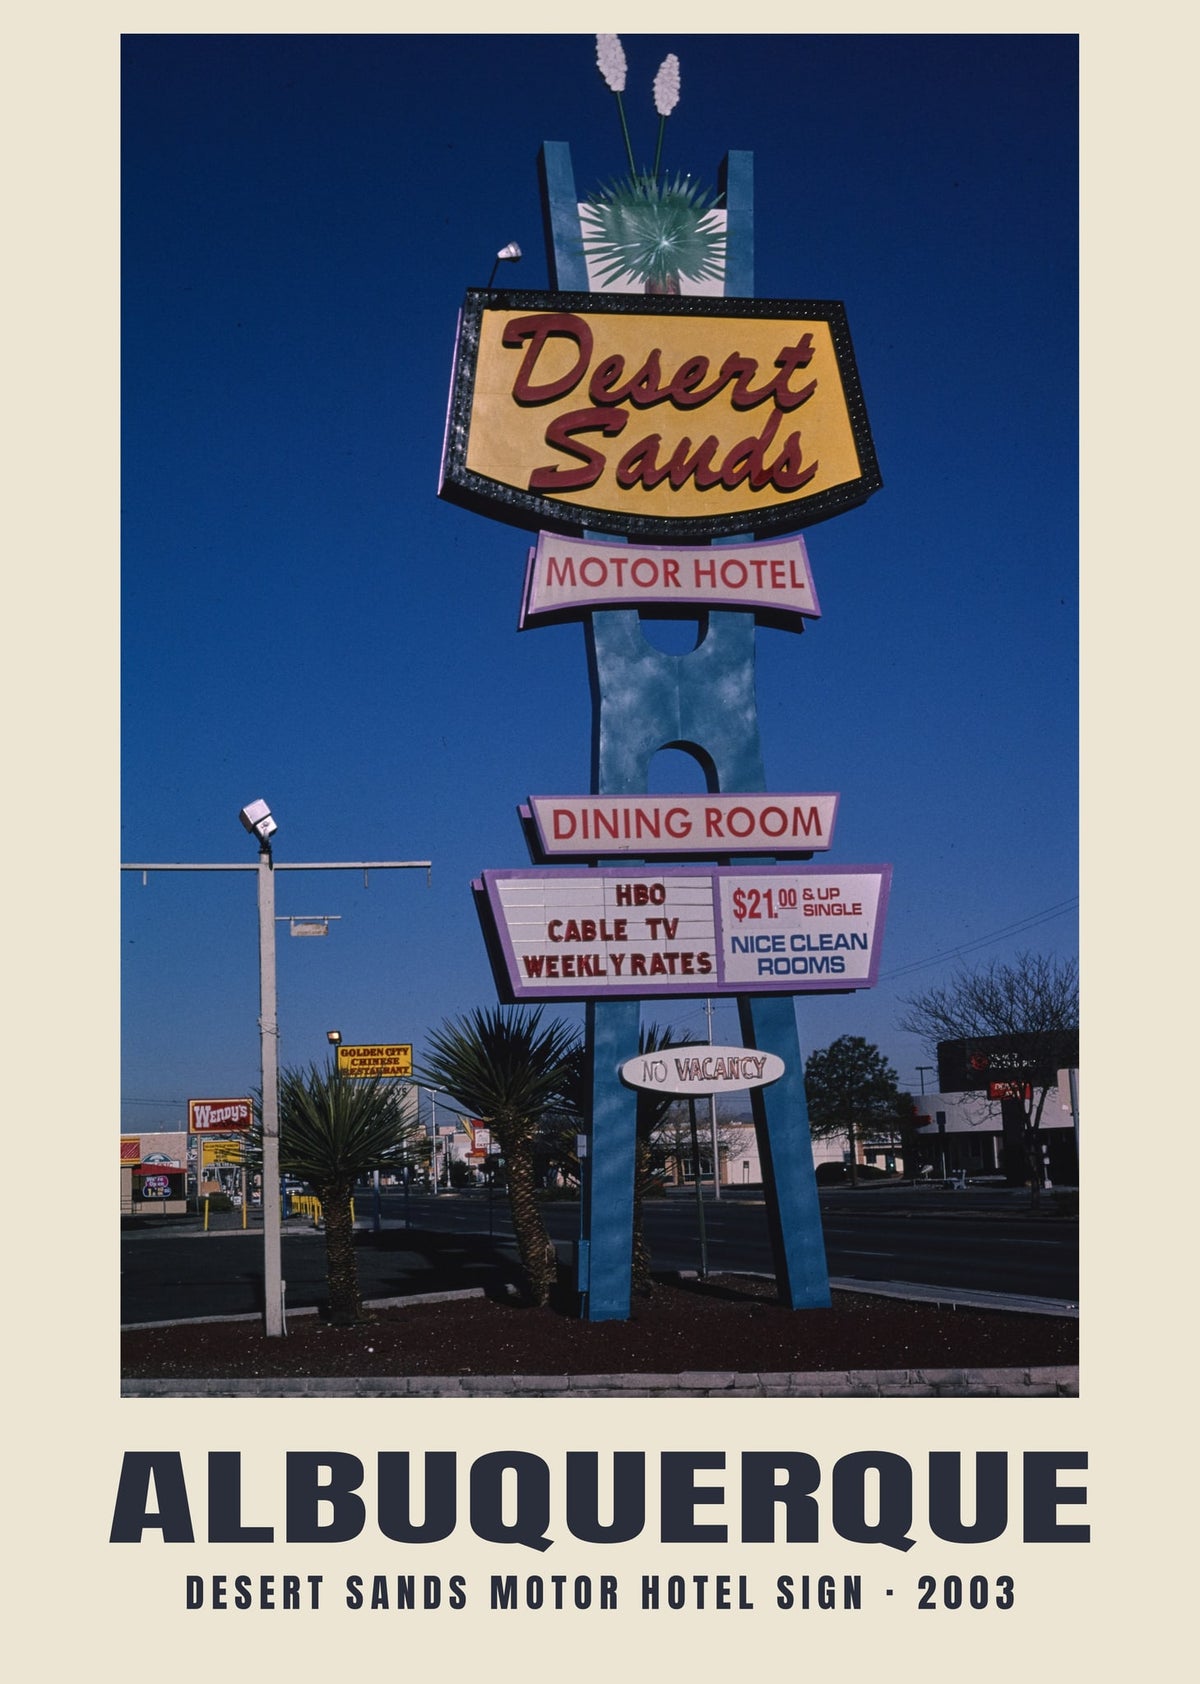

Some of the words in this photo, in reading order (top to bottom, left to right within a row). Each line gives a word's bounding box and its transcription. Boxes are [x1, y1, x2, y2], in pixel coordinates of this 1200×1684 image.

[502, 313, 818, 411] Desert
[529, 406, 819, 493] Sands
[546, 557, 682, 588] MOTOR
[694, 558, 805, 589] HOTEL
[553, 807, 693, 840] DINING
[705, 806, 823, 837] ROOM
[615, 883, 666, 907] HBO
[802, 888, 814, 900] &
[817, 888, 840, 900] UP
[803, 903, 863, 917] SINGLE
[548, 918, 628, 943] CABLE
[645, 917, 680, 940] TV
[731, 935, 786, 954] NICE
[790, 933, 868, 951] CLEAN
[522, 953, 625, 978] WEEKLY
[630, 951, 713, 976] RATES
[758, 955, 846, 976] ROOMS
[340, 1048, 384, 1057] GOLDEN
[385, 1047, 409, 1057] CITY
[351, 1057, 400, 1066] CHINESE
[641, 1059, 668, 1083] NO
[674, 1056, 767, 1082] VACANCY
